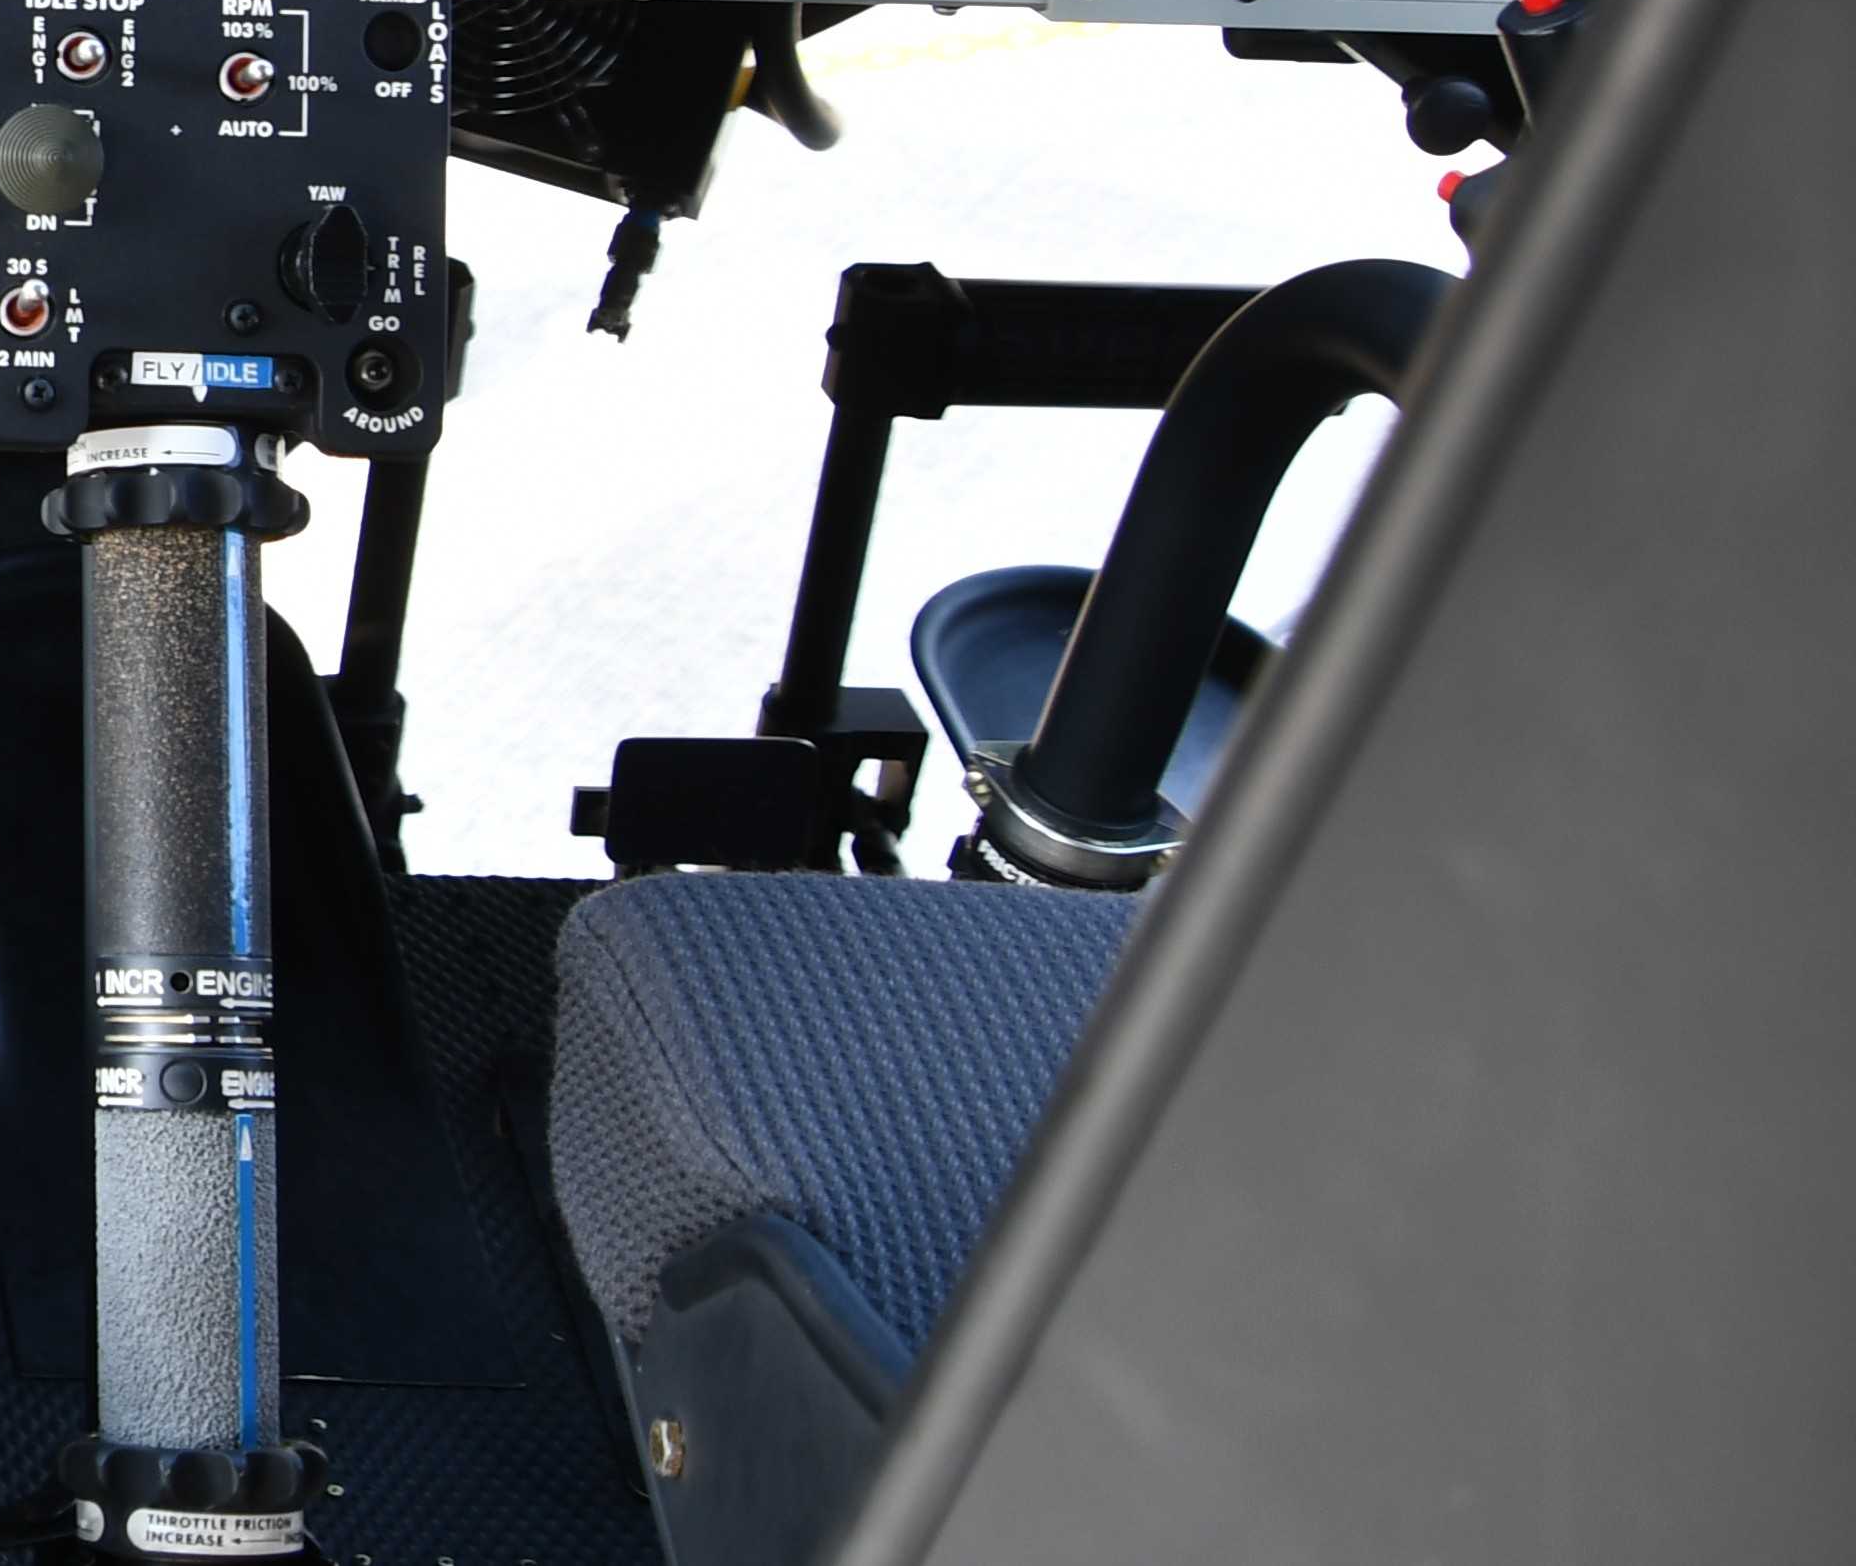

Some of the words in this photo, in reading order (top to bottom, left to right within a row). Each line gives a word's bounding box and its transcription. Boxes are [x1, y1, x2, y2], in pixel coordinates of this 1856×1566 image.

[222, 22, 273, 40] 103%
[288, 75, 337, 93] 100%
[375, 82, 412, 99] OFF
[219, 121, 273, 138] AUTO
[308, 186, 346, 201] YAW
[26, 215, 56, 232] DN
[7, 259, 30, 275] 30
[35, 259, 47, 275] S
[369, 316, 400, 332] GO
[14, 352, 54, 369] MIN
[342, 406, 424, 434] AROUND
[87, 447, 147, 463] INCREASE
[197, 970, 273, 997] ENGINE
[148, 1514, 227, 1531] THROTTLE
[235, 1515, 291, 1531] FRICTION
[146, 1531, 224, 1547] INCREASE
